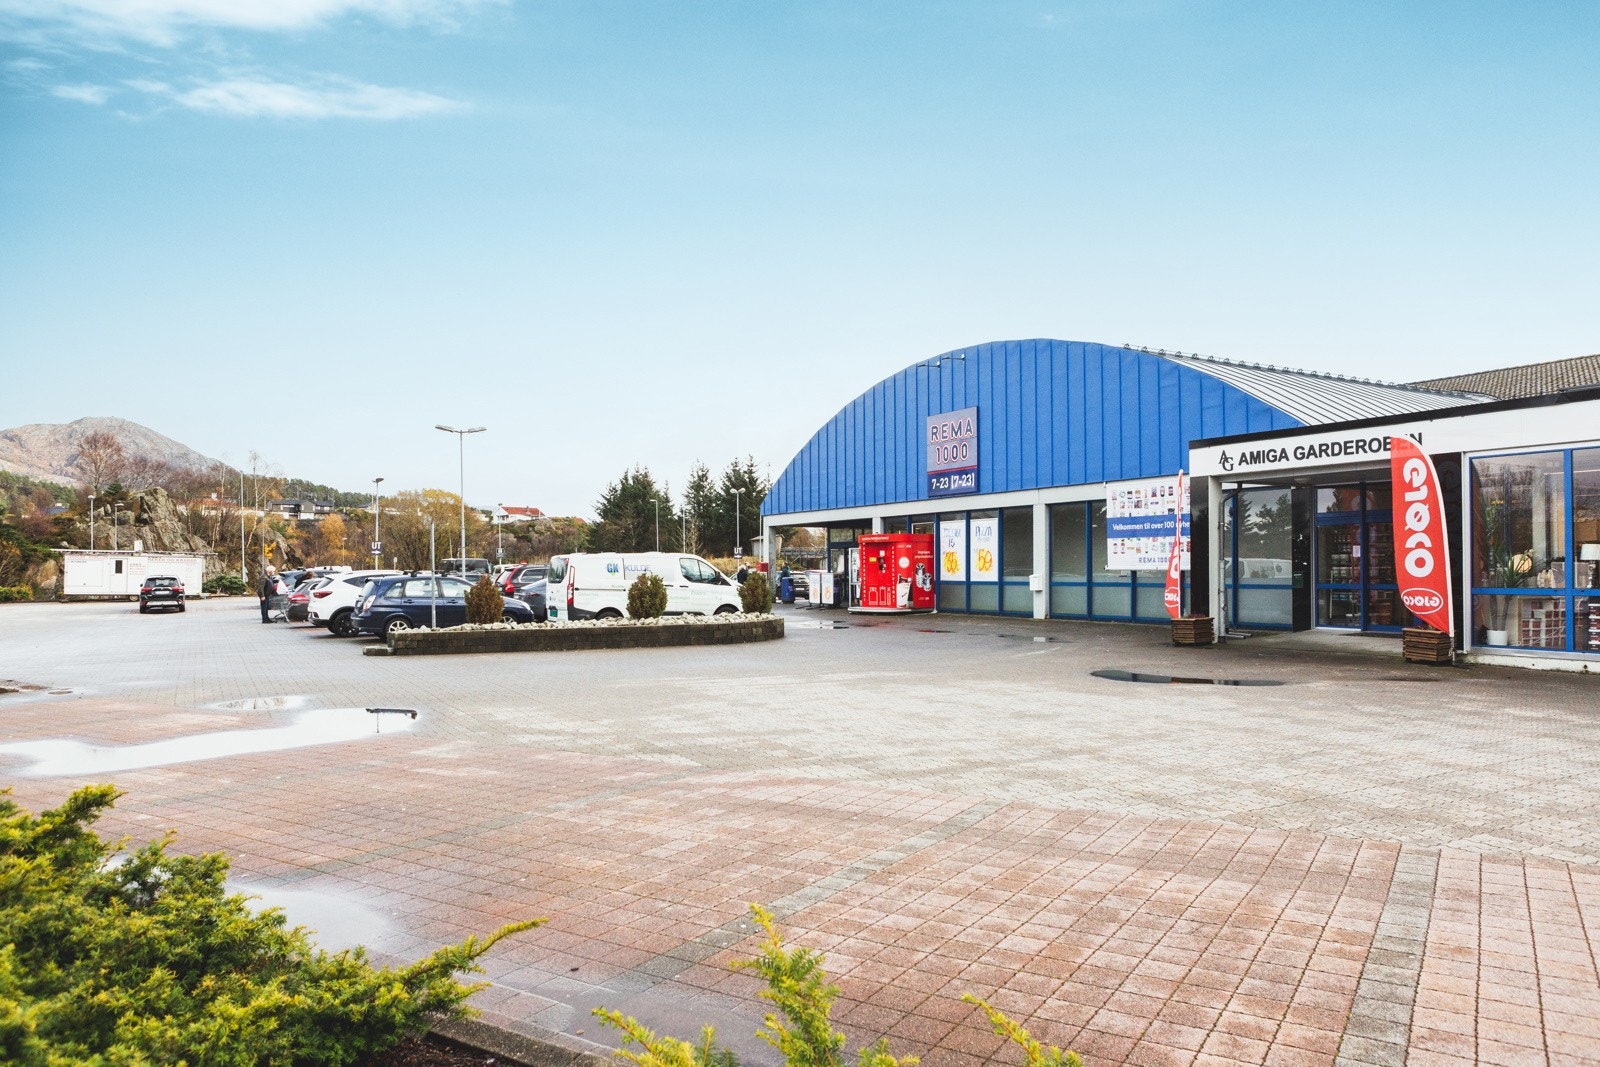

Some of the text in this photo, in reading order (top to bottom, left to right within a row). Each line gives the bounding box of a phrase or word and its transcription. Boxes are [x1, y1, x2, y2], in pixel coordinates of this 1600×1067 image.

[930, 417, 974, 443] REMA
[935, 442, 968, 465] 1000
[1238, 447, 1290, 466] AMIGA
[931, 477, 949, 490] 7-23
[1112, 523, 1144, 531] Velkommen
[1150, 522, 1163, 530] over
[1164, 521, 1175, 529] 100
[371, 541, 382, 550] UT
[734, 547, 743, 555] UT
[978, 548, 993, 572] 59
[606, 563, 651, 573] GK KULDE
